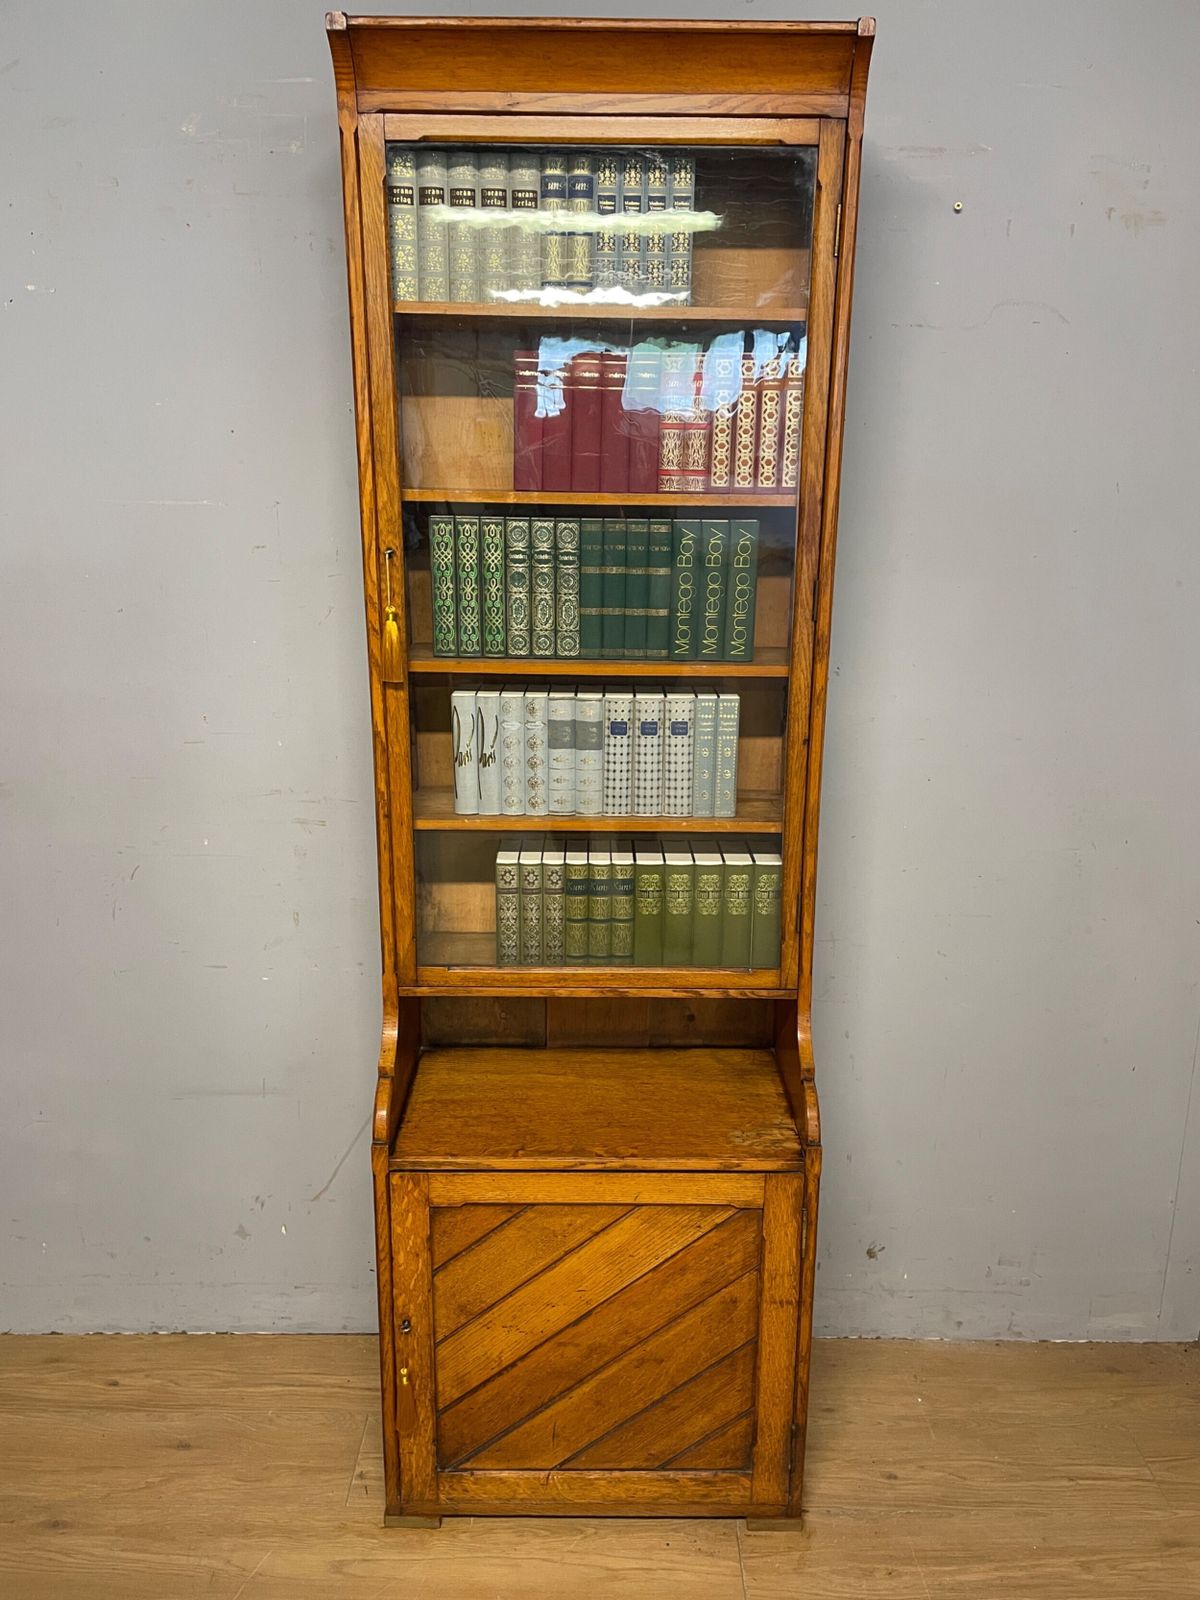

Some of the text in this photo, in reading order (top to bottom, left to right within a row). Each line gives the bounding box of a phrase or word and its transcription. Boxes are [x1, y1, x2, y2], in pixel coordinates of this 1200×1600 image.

[674, 528, 697, 654] Montego Bay
[702, 528, 727, 654] Montego Bay
[730, 528, 756, 655] Montego Bay
